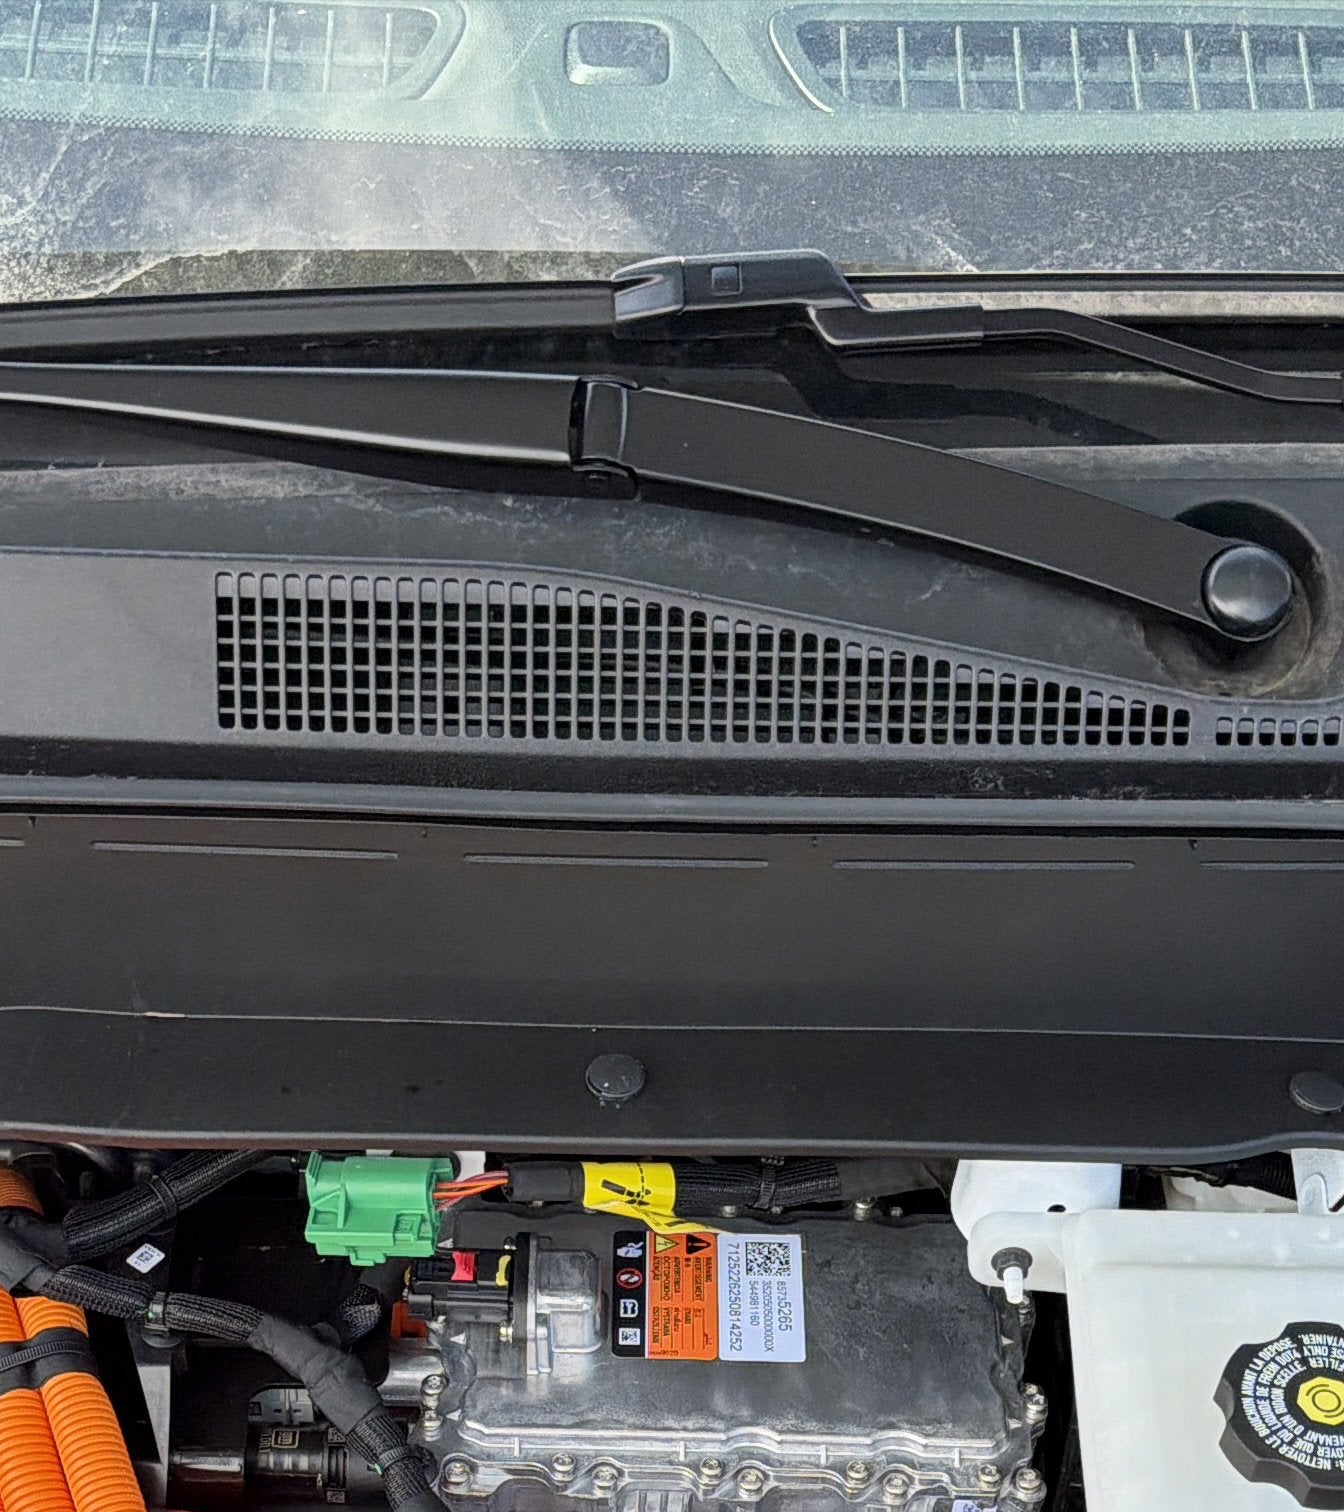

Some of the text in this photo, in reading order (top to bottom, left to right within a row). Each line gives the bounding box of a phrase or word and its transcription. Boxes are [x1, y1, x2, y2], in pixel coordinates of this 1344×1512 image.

[776, 1280, 792, 1332] 85735265
[1303, 1346, 1328, 1356] ONLY
[1248, 1358, 1265, 1370] LA
[1258, 1361, 1281, 1386] FREIN
[1241, 1368, 1257, 1396] AVANT
[1256, 1385, 1270, 1396] DE
[1270, 1388, 1288, 1414] BIDON
[1241, 1398, 1270, 1437] BOUCHON
[1256, 1399, 1282, 1431] LIQUIDE
[1264, 1434, 1282, 1448] LE
[1276, 1428, 1294, 1442] DU
[1292, 1438, 1314, 1454] QUE
[1278, 1444, 1332, 1470] NETTOYER
